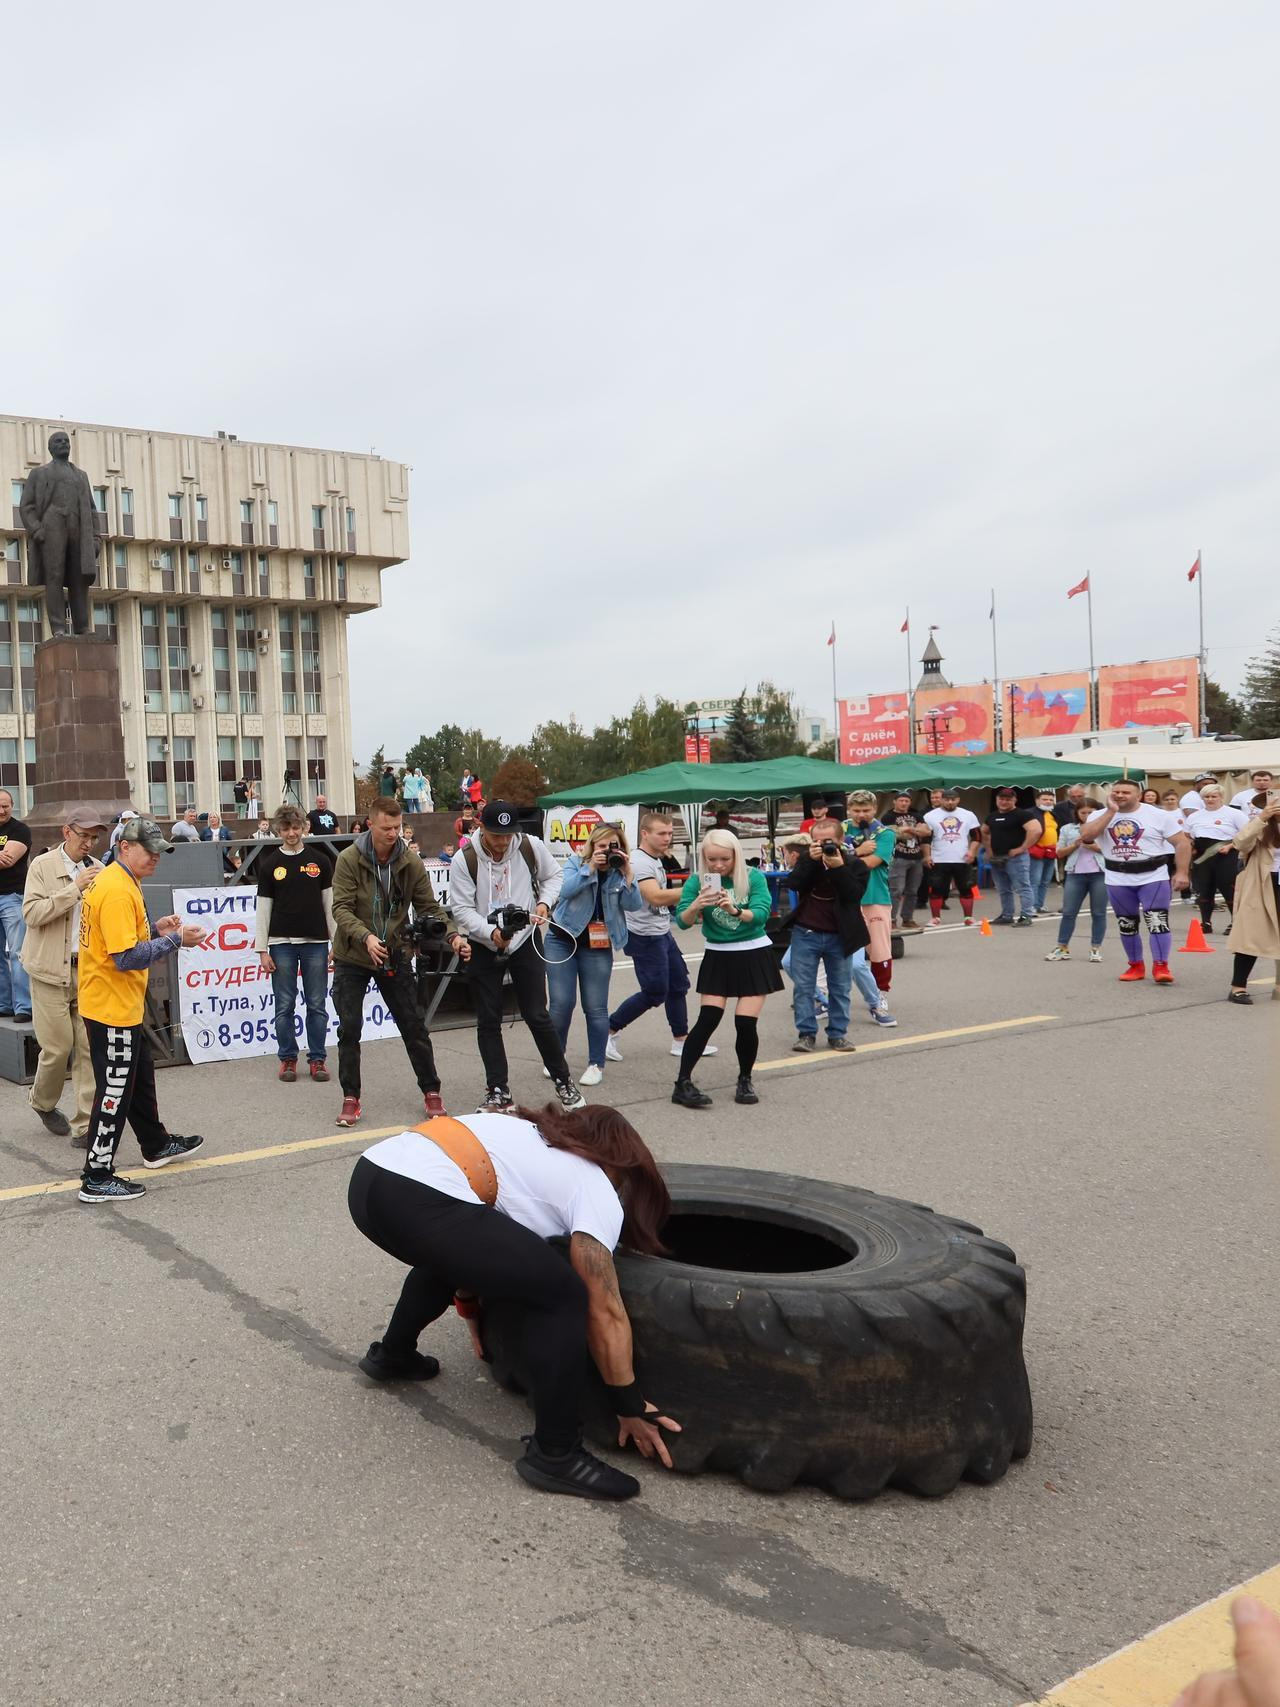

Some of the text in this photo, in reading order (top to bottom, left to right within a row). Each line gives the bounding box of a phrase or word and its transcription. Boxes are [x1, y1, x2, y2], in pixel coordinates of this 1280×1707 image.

[849, 730, 896, 743] С днём
[849, 746, 901, 757] города,
[186, 895, 256, 915] ФИТ
[192, 1002, 203, 1014] г.
[208, 996, 254, 1017] Тула,
